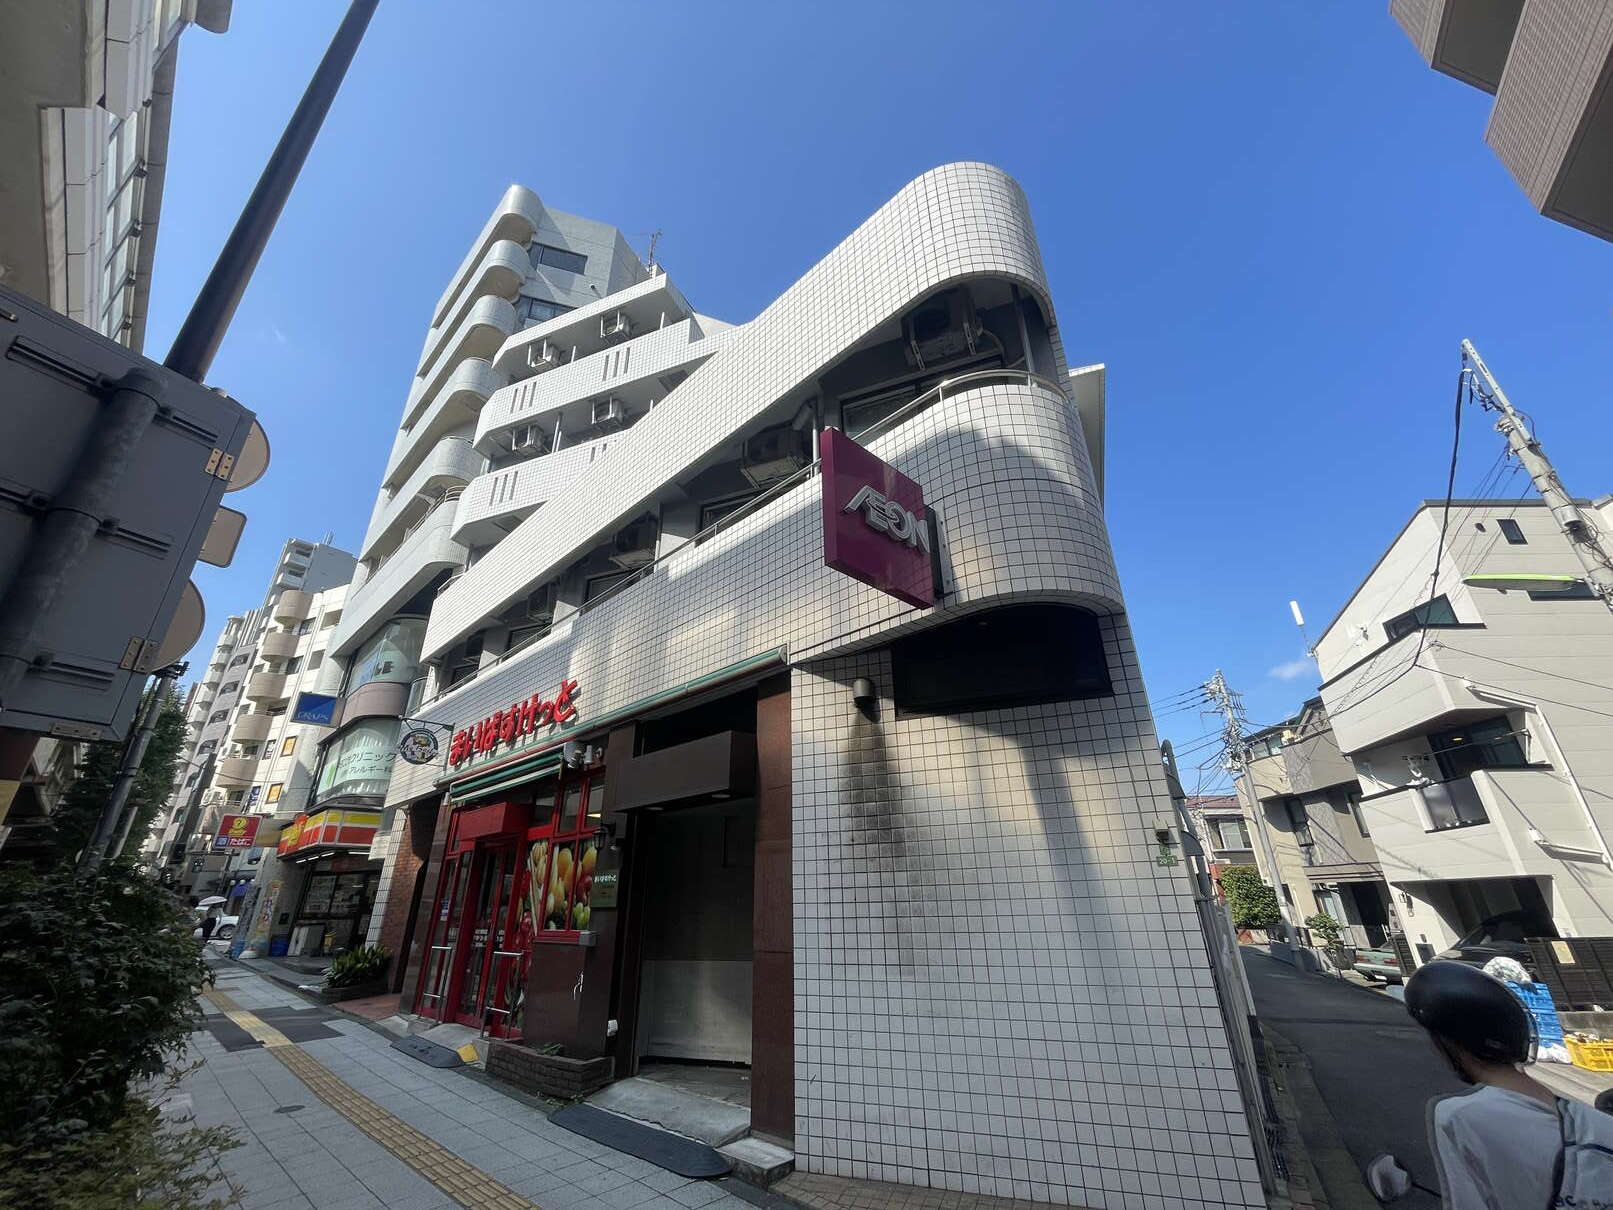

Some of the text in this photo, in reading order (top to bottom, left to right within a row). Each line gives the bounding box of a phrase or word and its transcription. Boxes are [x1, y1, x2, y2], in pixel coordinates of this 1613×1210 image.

[842, 485, 931, 553] AEON
[449, 679, 578, 766] まいばすけっと
